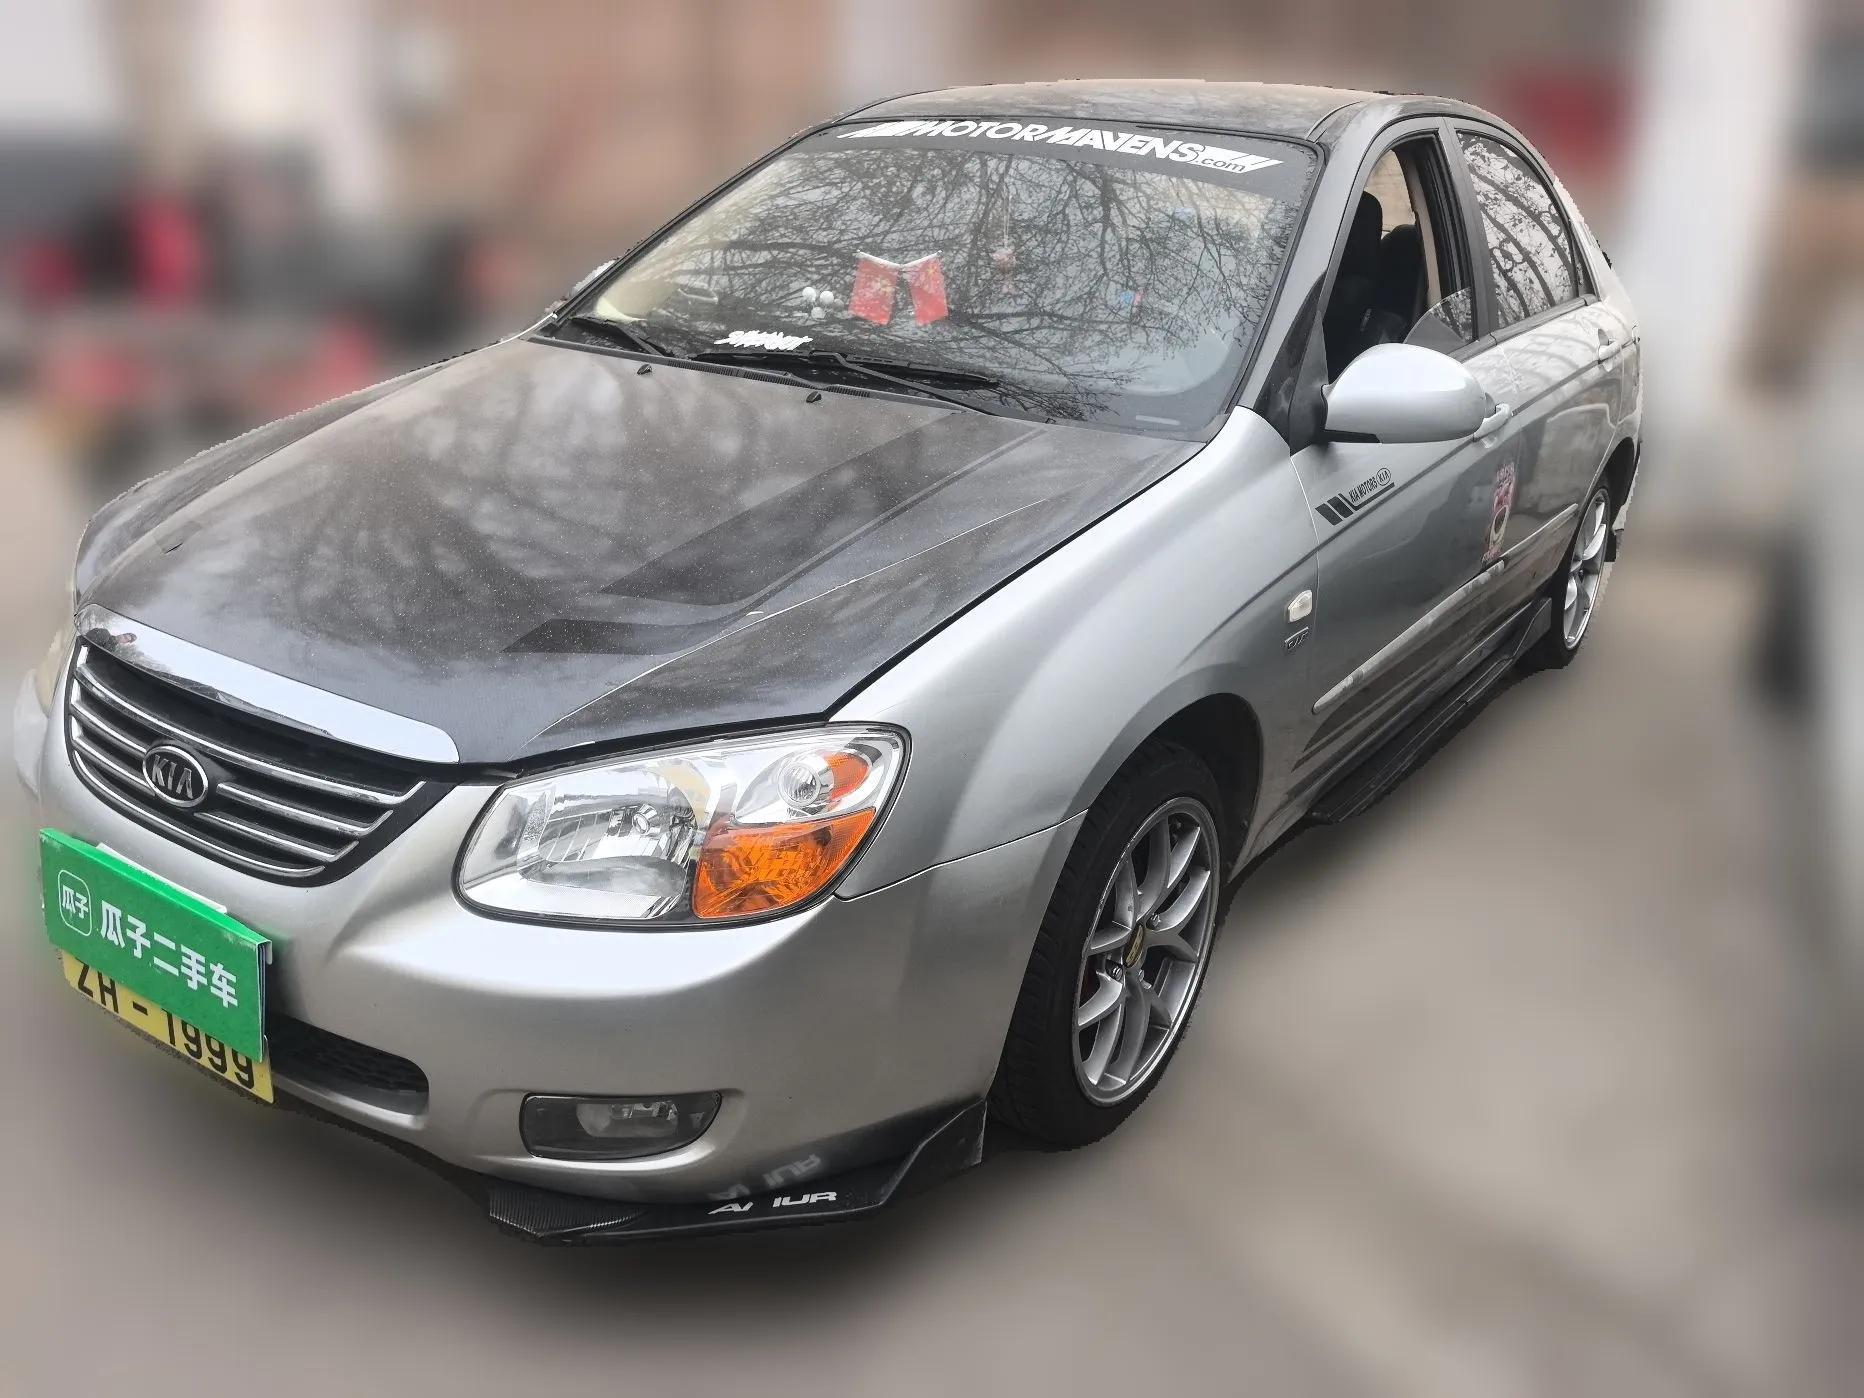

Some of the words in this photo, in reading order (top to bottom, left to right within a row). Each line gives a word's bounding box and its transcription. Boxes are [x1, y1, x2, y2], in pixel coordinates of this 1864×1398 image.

[1357, 477, 1378, 498] MOTORS
[1378, 470, 1390, 483] KIA
[152, 754, 194, 799] KIA
[61, 884, 89, 918] 瓜子
[101, 900, 238, 1008] 瓜子二手车
